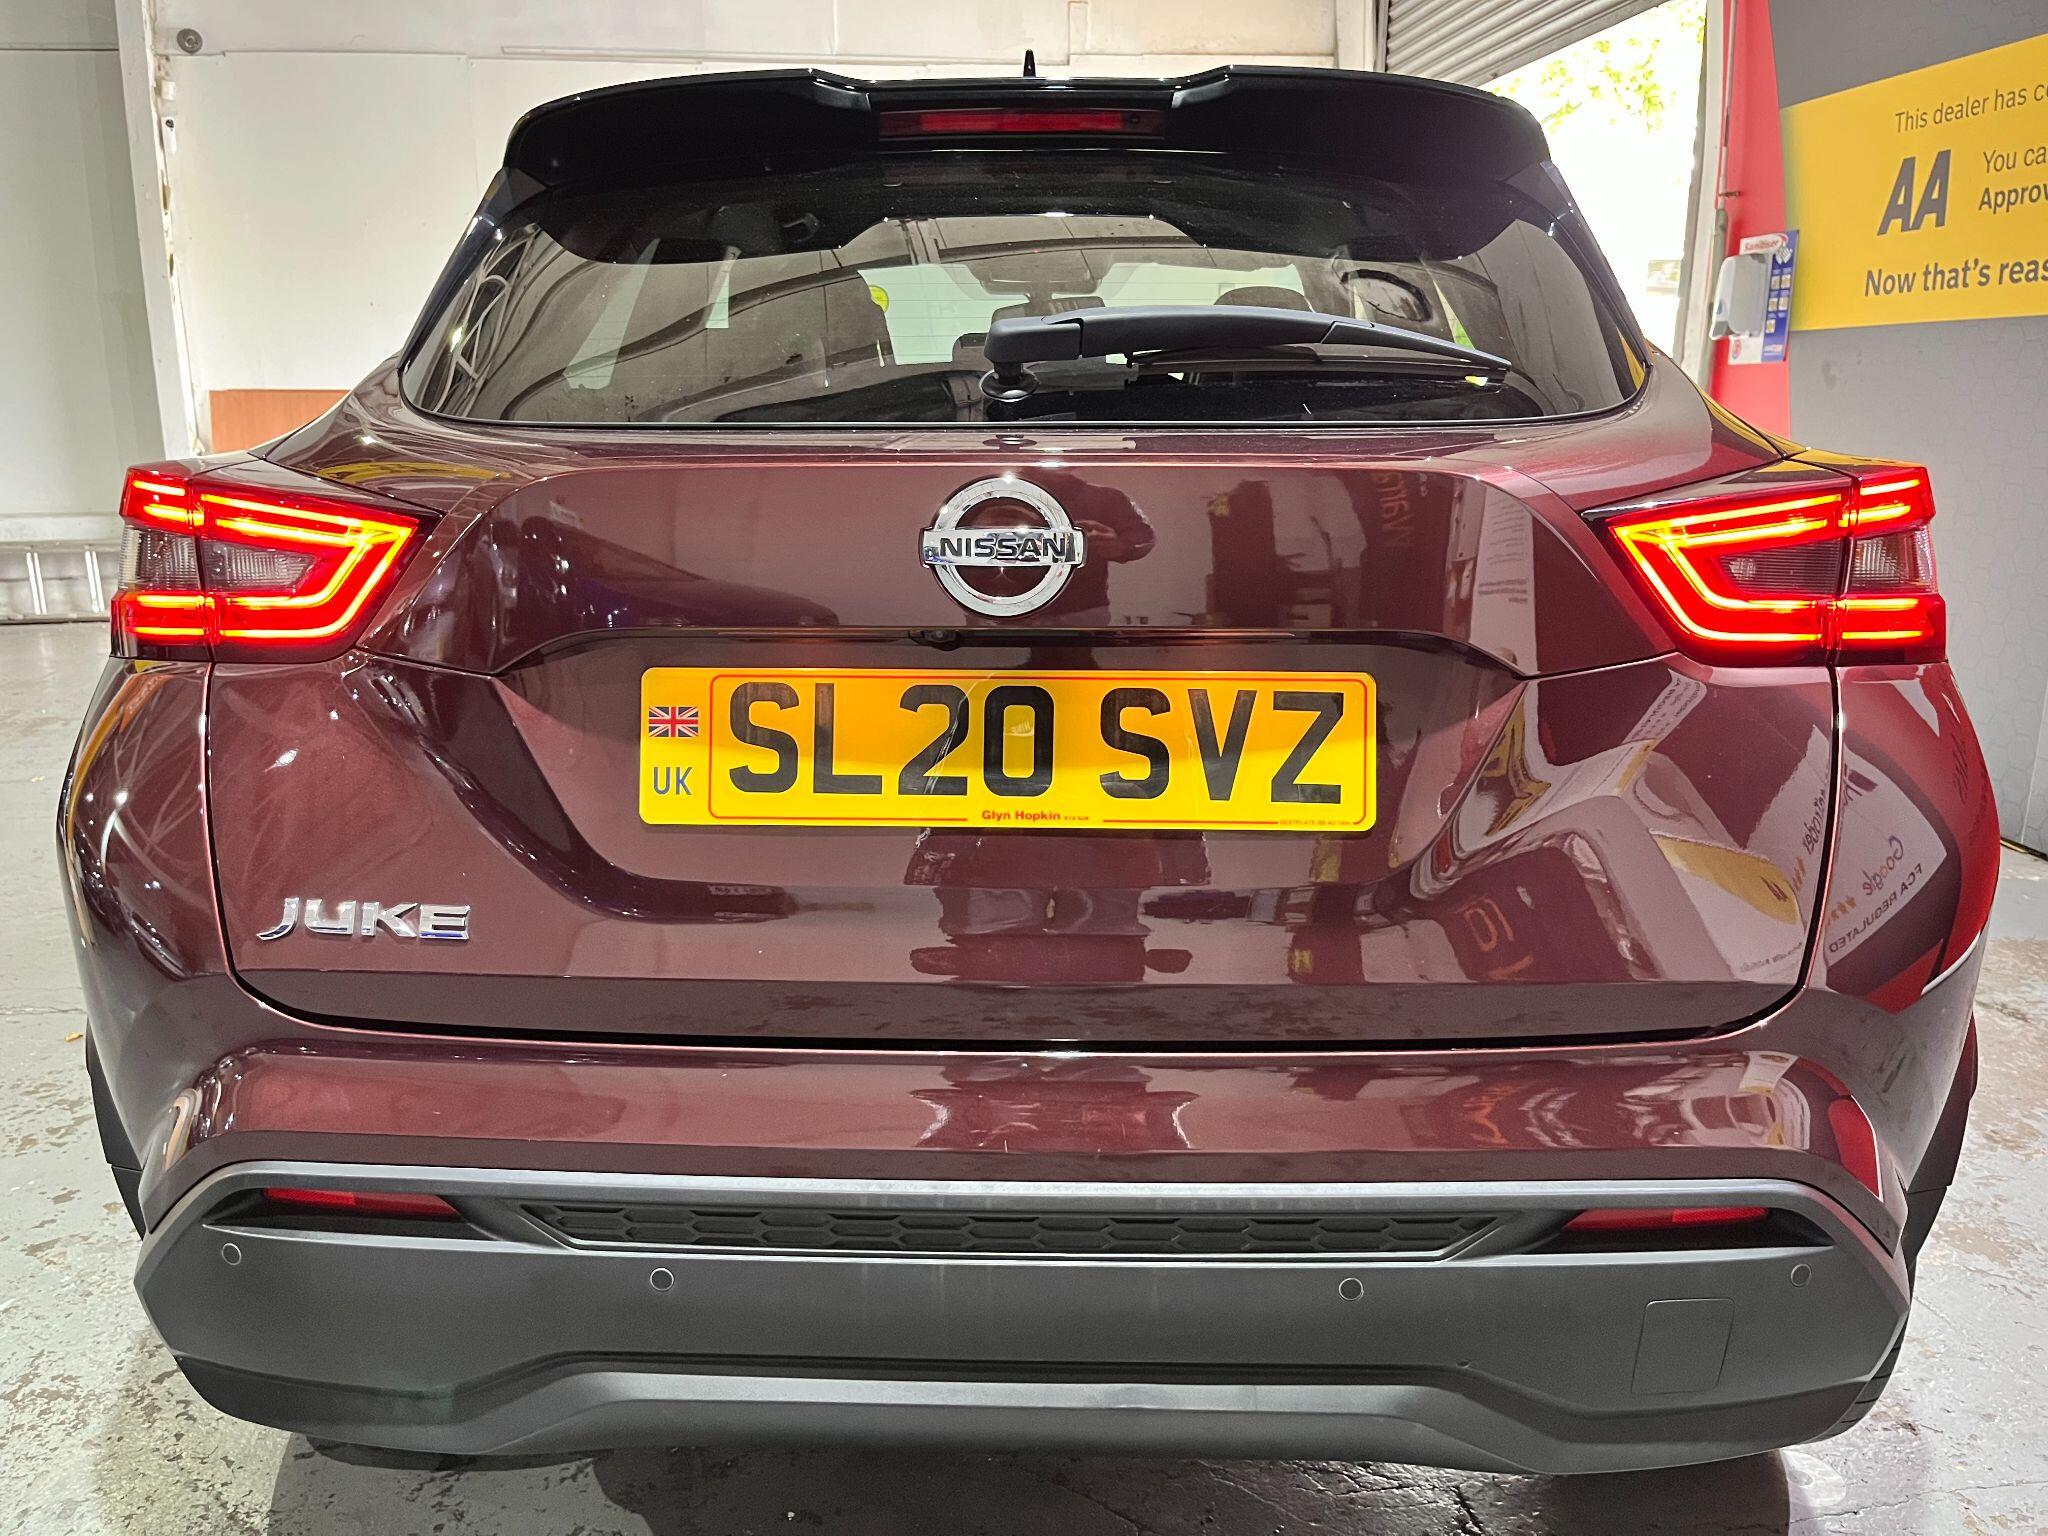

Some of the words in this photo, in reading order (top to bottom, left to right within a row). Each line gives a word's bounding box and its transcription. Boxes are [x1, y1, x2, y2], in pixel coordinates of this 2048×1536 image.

[1895, 108, 1927, 133] This
[1933, 96, 1989, 125] dealer
[1994, 89, 2027, 111] has
[2034, 84, 2048, 101] c
[1983, 150, 2017, 174] You
[1877, 149, 1951, 236] AA
[1865, 268, 1916, 297] Now
[1923, 258, 1991, 292] that's
[939, 537, 1066, 558] NISSAN
[728, 682, 1054, 797] SL20
[1099, 687, 1345, 804] SVZ
[652, 766, 693, 795] UK
[982, 810, 1011, 822] Glyn
[1015, 810, 1061, 822] Hopkin
[256, 897, 471, 941] JUKE
